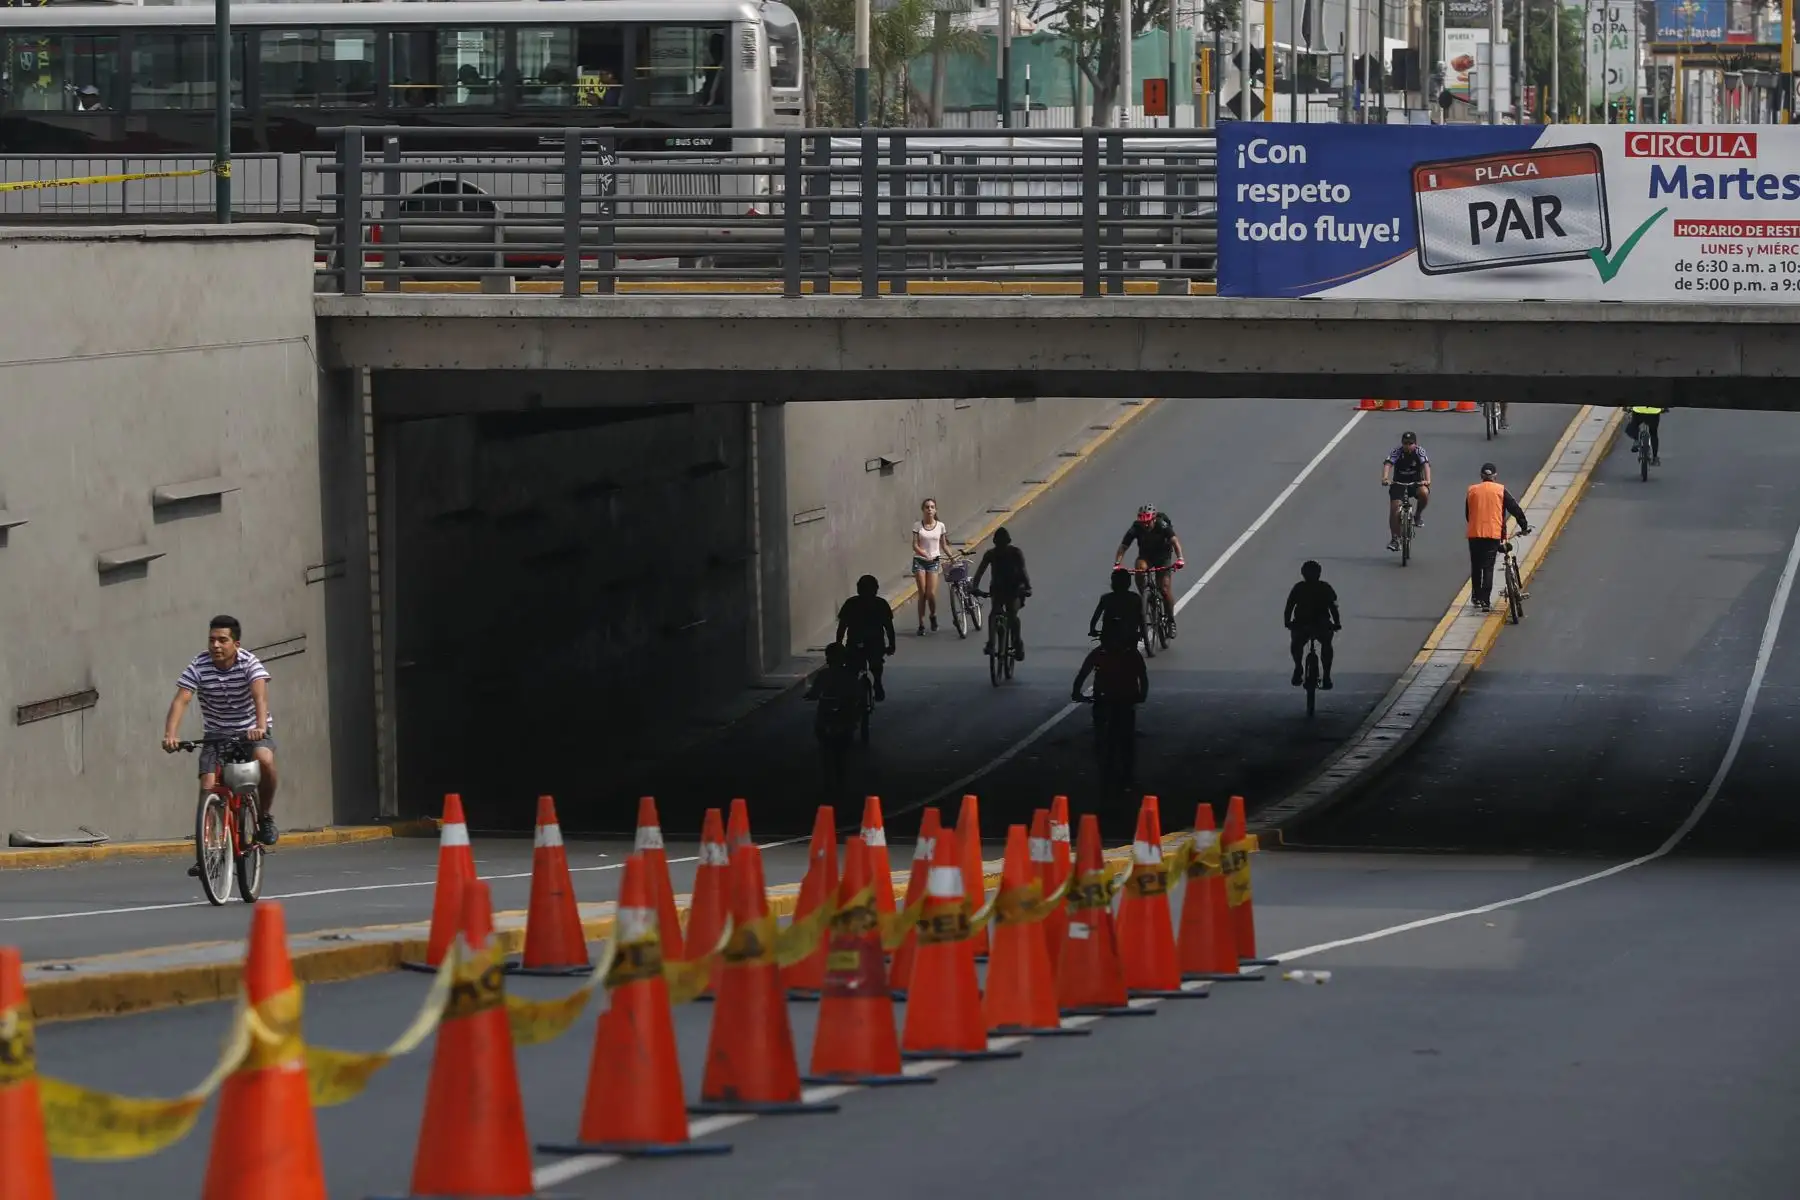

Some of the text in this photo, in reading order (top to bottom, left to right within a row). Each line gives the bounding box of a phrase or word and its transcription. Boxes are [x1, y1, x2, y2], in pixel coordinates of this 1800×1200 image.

[1592, 23, 1627, 34] DPA
[1657, 27, 1722, 38] cinelanet
[675, 138, 713, 146] BUS GNV
[1630, 134, 1752, 157] CIRCULA
[1237, 138, 1307, 169] ¡Con
[1475, 162, 1540, 181] PLACA
[1649, 164, 1800, 201] Martes
[1237, 179, 1351, 210] respeto
[1468, 194, 1568, 246] PAR
[1235, 215, 1400, 249] todo fluye!
[1678, 224, 1743, 236] HORARIO
[1745, 225, 1764, 237] DE
[1701, 242, 1799, 258] LUNES y MIÉRC
[1674, 259, 1693, 272] de
[1696, 260, 1728, 273] 6:30
[1732, 263, 1764, 273] a.m.
[1768, 263, 1777, 273] a
[1674, 277, 1693, 290] de
[1696, 278, 1730, 291] 5:00
[1733, 281, 1766, 294] p.m.
[1770, 281, 1779, 291] a
